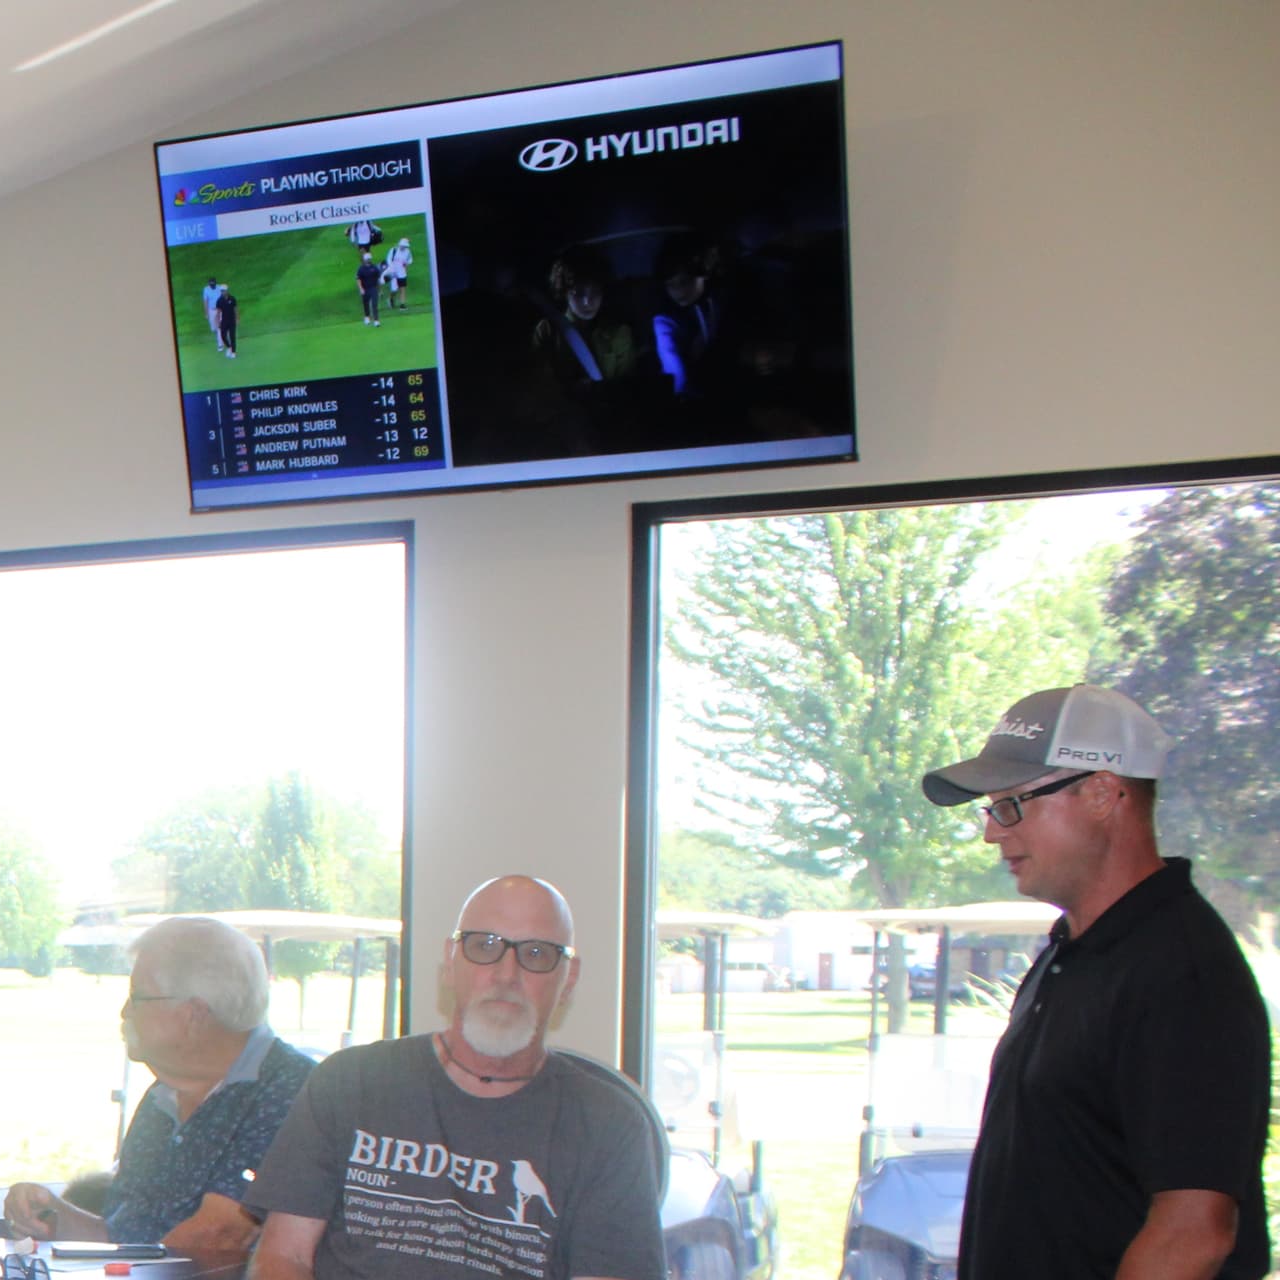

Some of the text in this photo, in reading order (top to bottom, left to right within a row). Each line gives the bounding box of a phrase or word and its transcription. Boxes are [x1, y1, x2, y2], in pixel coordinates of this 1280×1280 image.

[585, 117, 740, 162] HYUNDAI
[197, 158, 412, 207] Sports PLAYING THROUGH
[269, 202, 370, 226] Rocket Classic
[175, 223, 205, 240] LIVE
[206, 396, 212, 406] 1
[249, 389, 280, 402] CHRIS
[283, 385, 308, 398] KIRK
[371, 376, 394, 389] -14
[407, 374, 424, 386] 65
[251, 406, 283, 419] PHILIP
[287, 401, 338, 416] KNOWLES
[373, 394, 396, 407] -14
[409, 392, 424, 404] 64
[209, 430, 216, 440] 3
[252, 423, 299, 437] JACKSON
[303, 419, 337, 433] SUBER
[375, 412, 398, 425] -13
[410, 410, 427, 422] 65
[254, 439, 299, 454] ANDREW
[302, 435, 347, 450] PUTNAM
[376, 429, 399, 442] -13
[412, 427, 428, 440] 12
[212, 464, 219, 474] 5
[256, 459, 286, 472] MARK
[289, 454, 339, 468] HUBBARD
[377, 447, 400, 460] -12
[413, 445, 429, 457] 69
[348, 1128, 499, 1195] BIRDER
[346, 1167, 389, 1187] NOUN
[347, 1195, 384, 1210] person
[385, 1201, 413, 1213] often
[414, 1204, 443, 1217] found
[364, 1229, 385, 1238] talk
[385, 1231, 402, 1240] for
[402, 1231, 434, 1244] hours
[435, 1237, 465, 1249] about
[381, 1216, 398, 1227] for
[406, 1219, 428, 1228] rare
[469, 1233, 480, 1241] of
[376, 1242, 397, 1251] and
[398, 1244, 425, 1256] their
[426, 1247, 465, 1265] habitat
